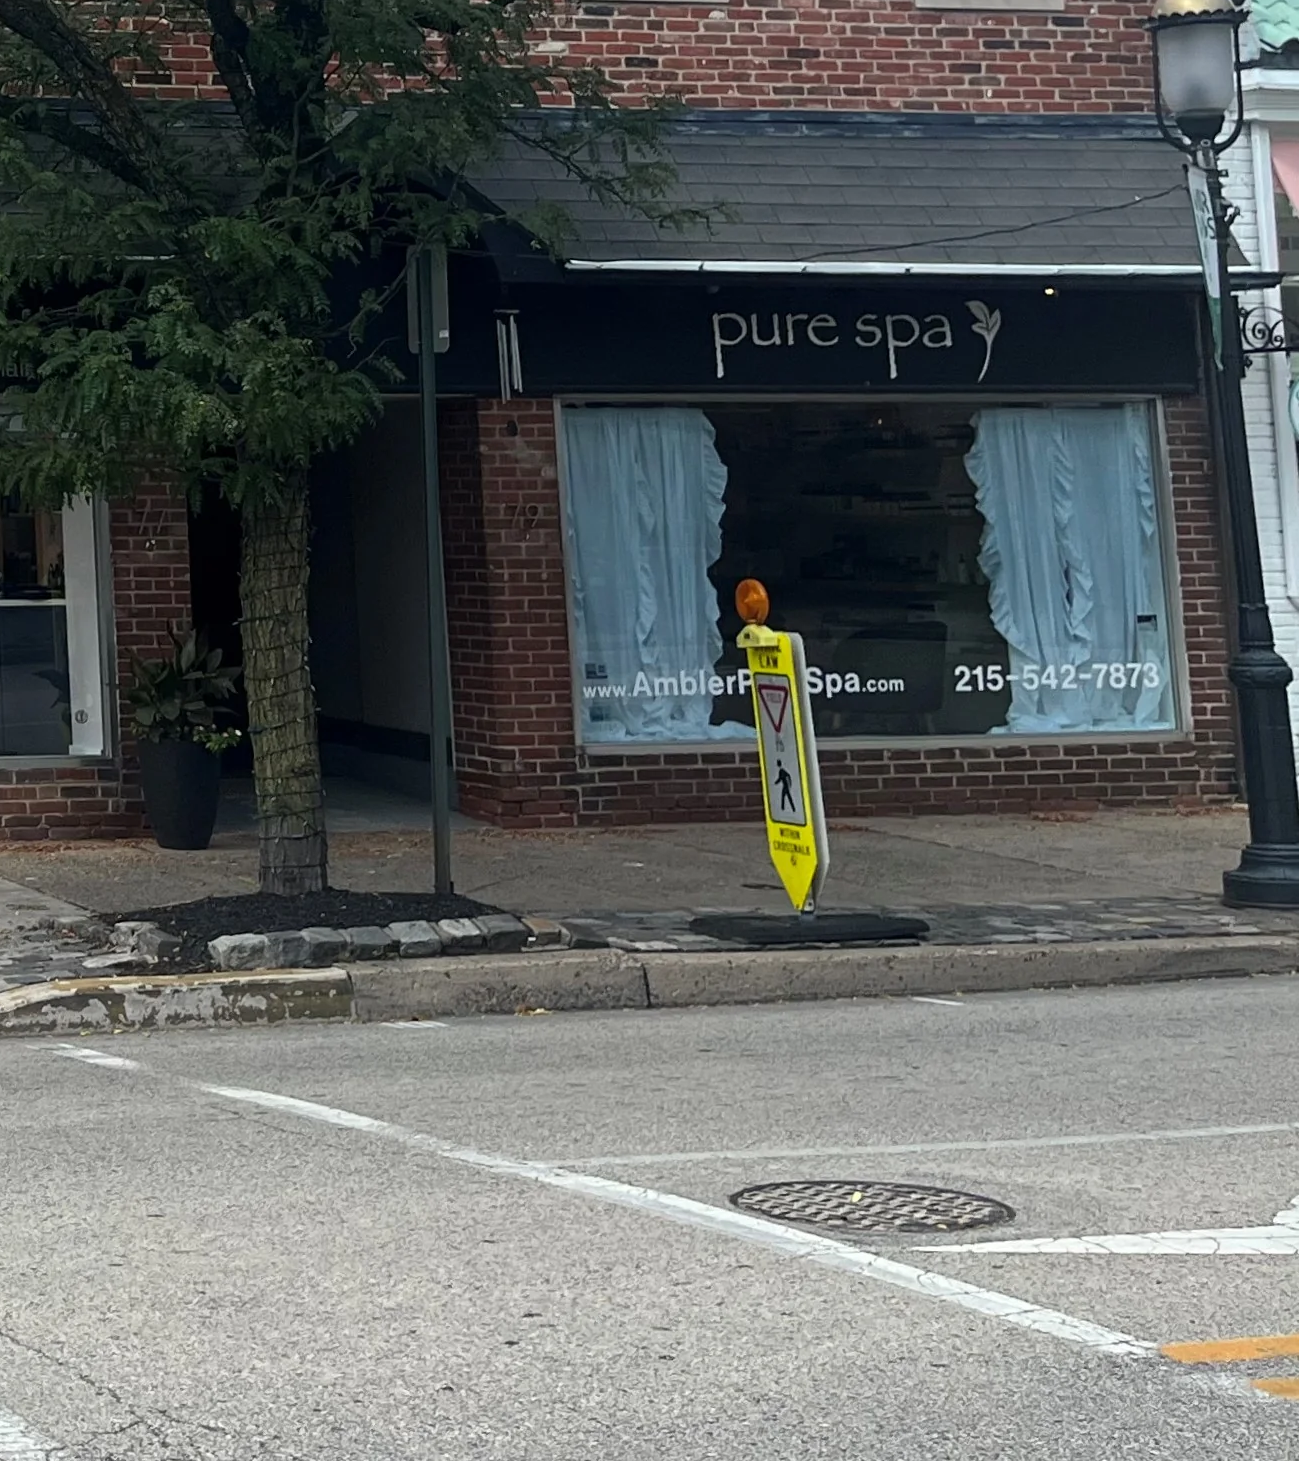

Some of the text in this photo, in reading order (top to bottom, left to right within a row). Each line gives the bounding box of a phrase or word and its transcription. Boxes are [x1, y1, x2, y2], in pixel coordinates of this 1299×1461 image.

[712, 312, 953, 379] pure spa
[503, 503, 540, 528] 79
[583, 663, 1160, 699] www.AmblerPSpa.com 215-542-7873
